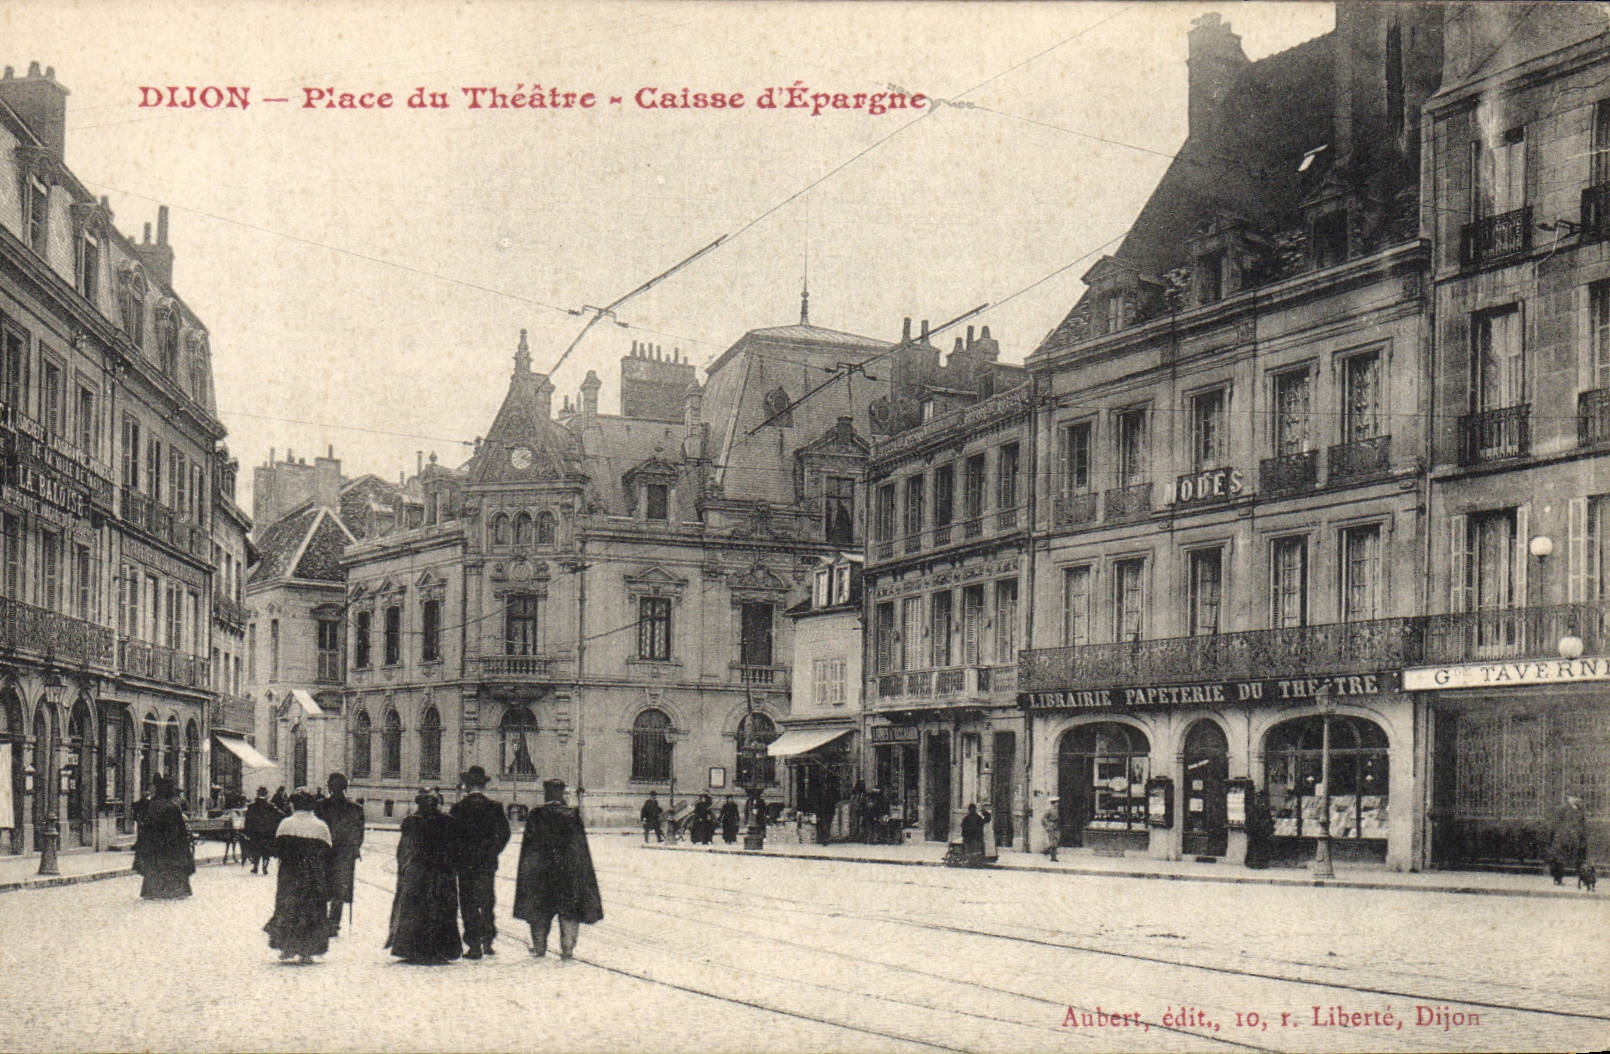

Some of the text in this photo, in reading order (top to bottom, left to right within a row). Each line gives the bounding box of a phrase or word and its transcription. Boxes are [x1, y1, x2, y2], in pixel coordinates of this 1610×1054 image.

[19, 463, 34, 492] LA
[1163, 470, 1244, 506] MODES
[1029, 674, 1379, 709] LIBRAIRIE PAPETERIE DU THETRE
